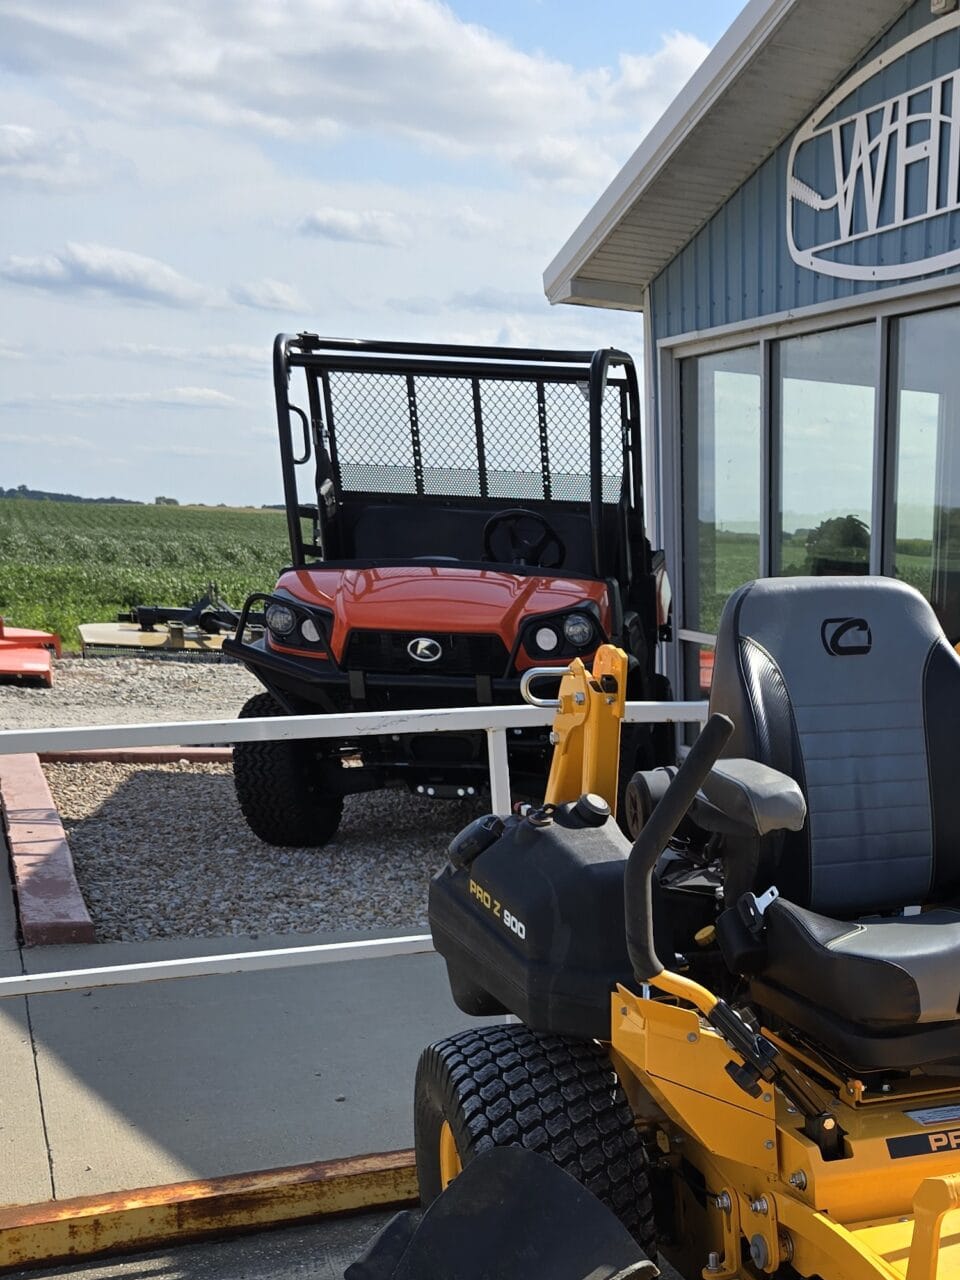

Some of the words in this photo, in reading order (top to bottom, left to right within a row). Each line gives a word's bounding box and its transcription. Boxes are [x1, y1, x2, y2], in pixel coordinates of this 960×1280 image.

[470, 879, 491, 909] PRO
[493, 900, 501, 918] Z
[503, 909, 526, 939] 900
